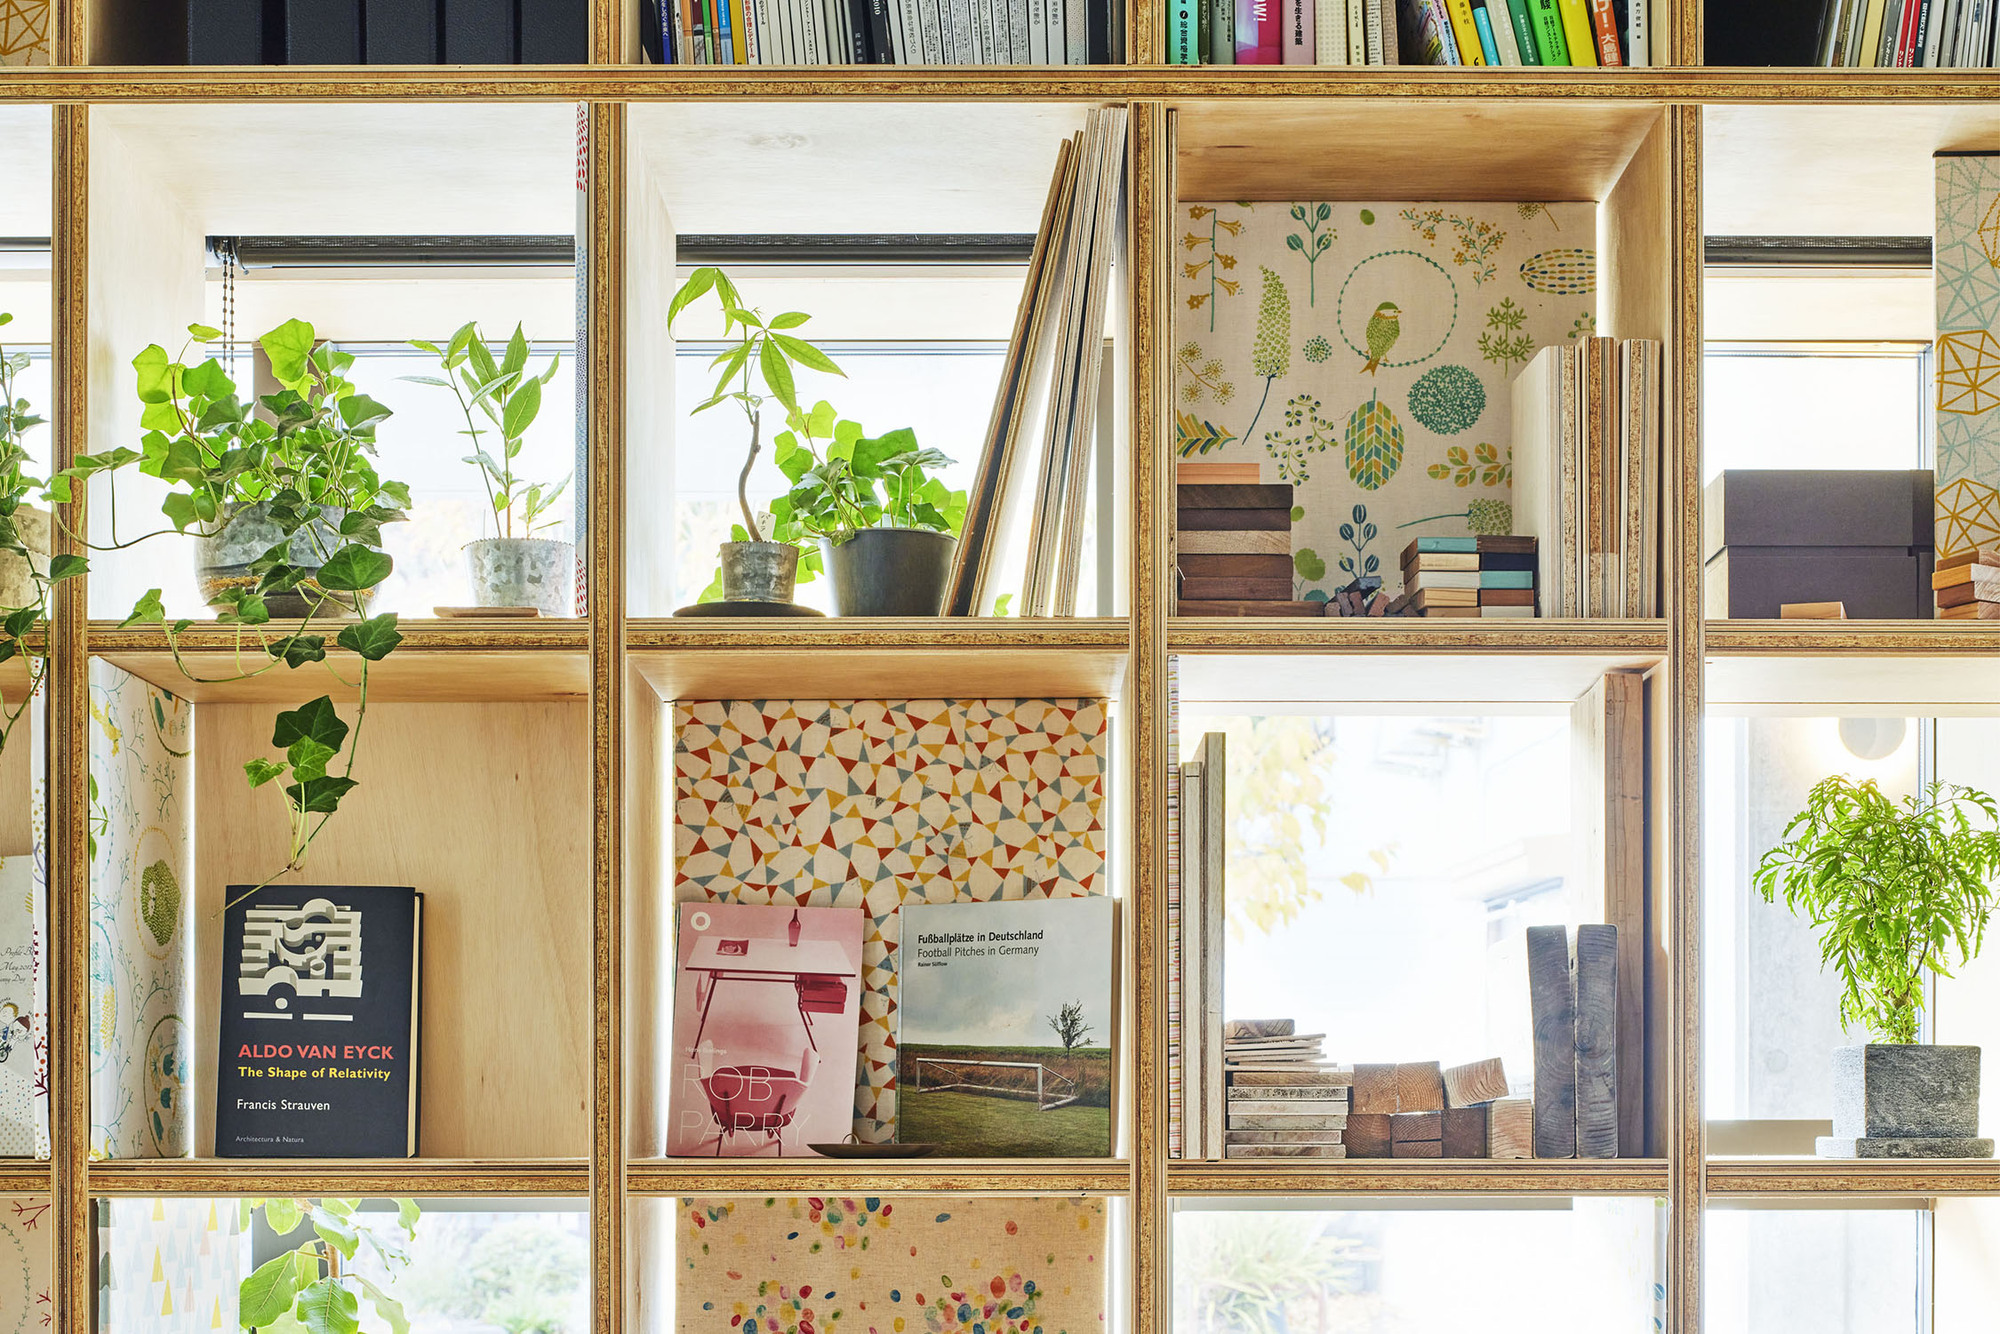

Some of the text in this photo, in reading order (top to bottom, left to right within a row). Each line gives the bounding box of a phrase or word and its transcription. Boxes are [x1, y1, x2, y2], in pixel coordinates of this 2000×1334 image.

[918, 930, 1044, 945] Fußballplätze in Deutschland
[917, 945, 1040, 958] Football Pitches in Germany
[238, 1044, 394, 1060] ALDO VAN EYCK
[238, 1066, 391, 1081] The Shape of Relativity
[682, 1064, 772, 1102] ROB
[237, 1099, 330, 1111] Francis Strauven
[679, 1111, 812, 1147] PARRY
[235, 1135, 274, 1143] Architectura
